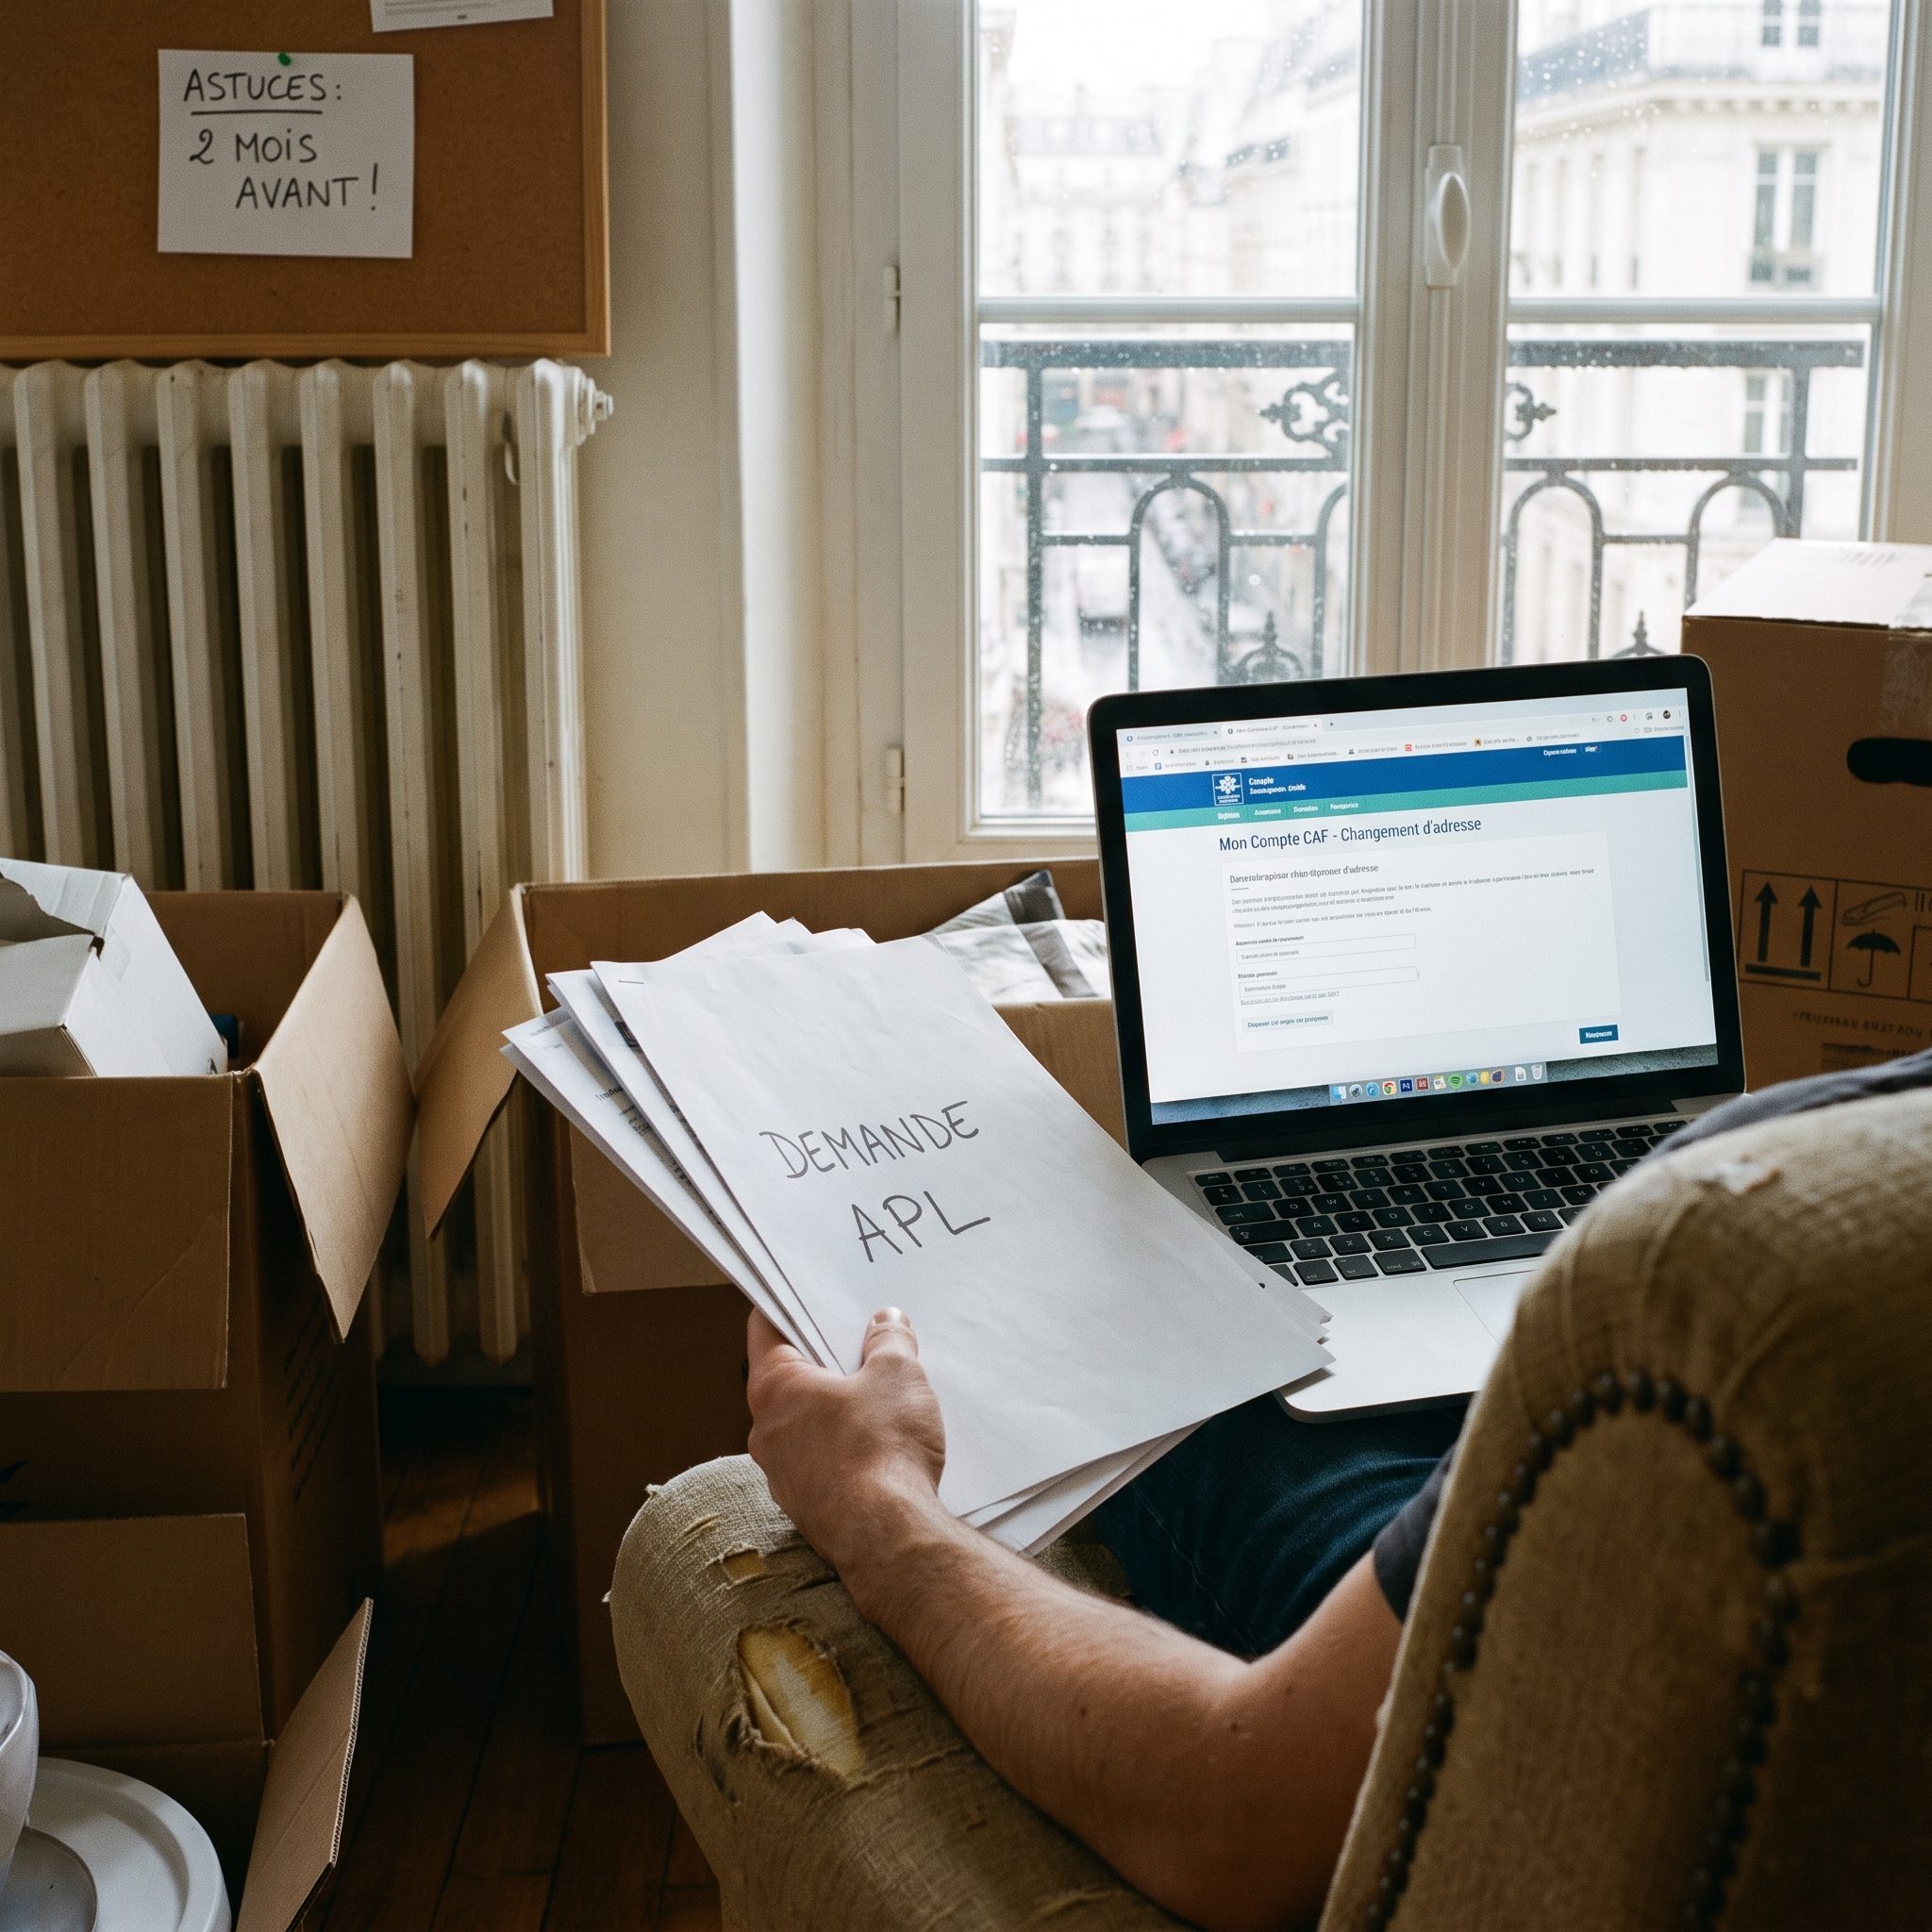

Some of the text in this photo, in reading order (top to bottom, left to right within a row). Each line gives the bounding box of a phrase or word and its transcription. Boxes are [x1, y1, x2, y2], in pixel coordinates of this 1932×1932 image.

[189, 128, 214, 165] 2
[1219, 837, 1247, 851] Mon
[1250, 832, 1301, 854] Compte
[1303, 829, 1329, 844] CAF
[1341, 822, 1420, 842] Changement
[1423, 818, 1482, 836] d'adresse
[758, 1100, 979, 1179] DEMANDE
[851, 1191, 991, 1263] APL
